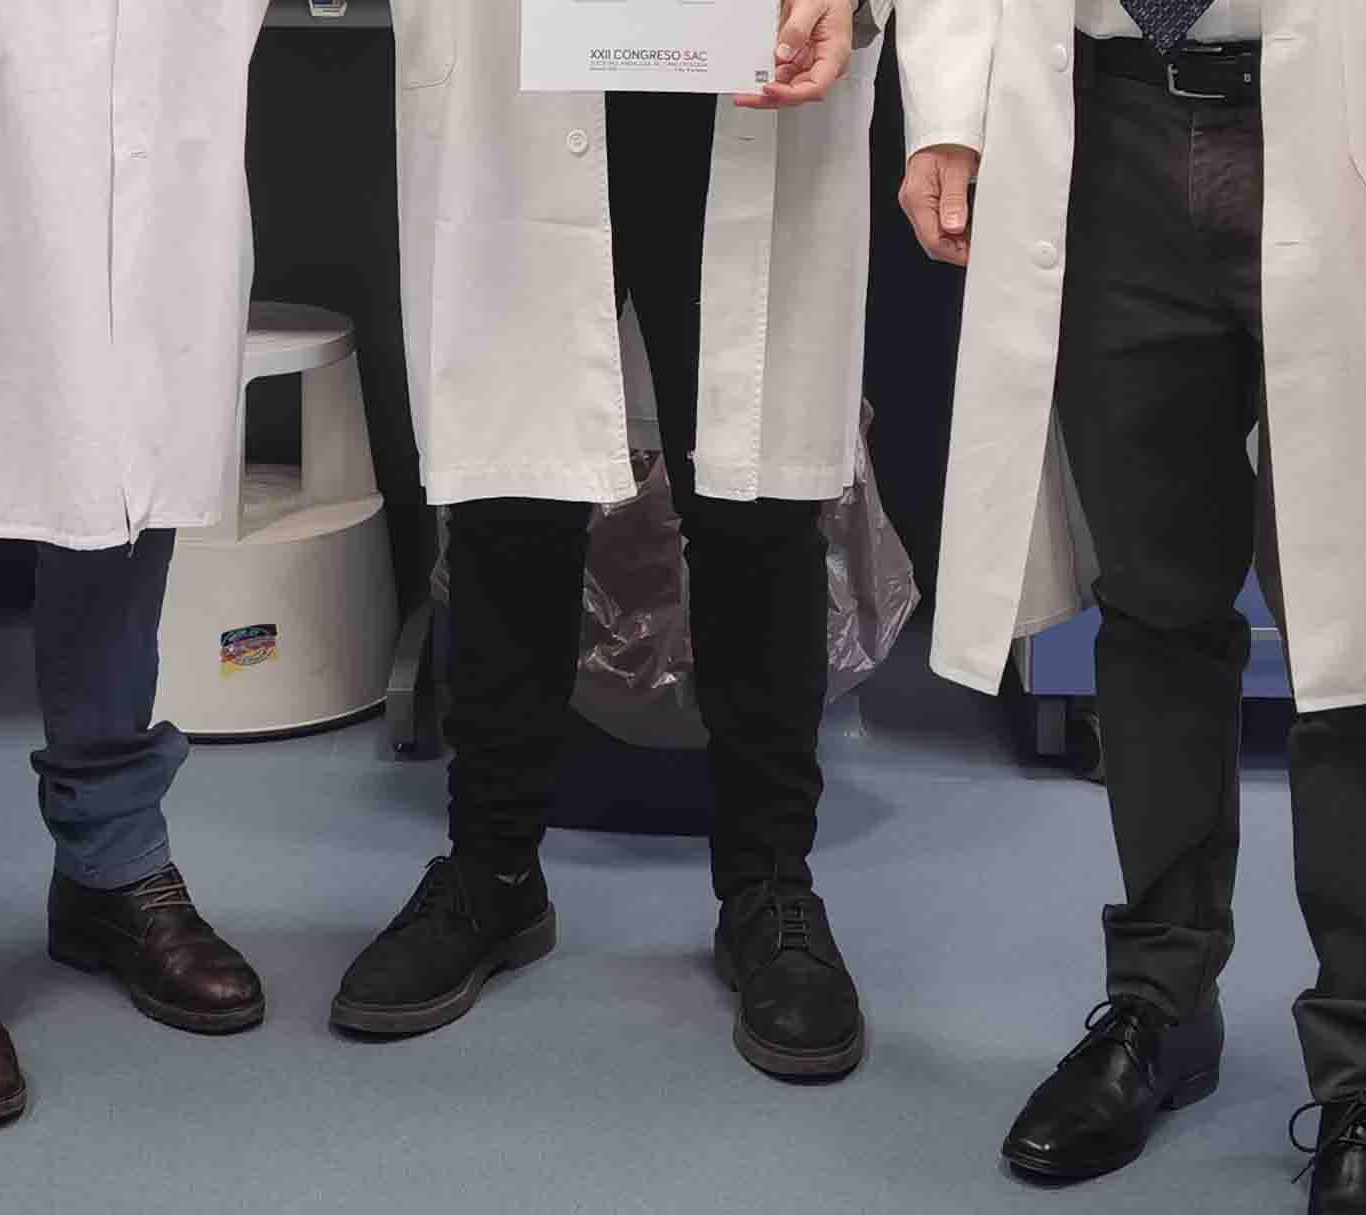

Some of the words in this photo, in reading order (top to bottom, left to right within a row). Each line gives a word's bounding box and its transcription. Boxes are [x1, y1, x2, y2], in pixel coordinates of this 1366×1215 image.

[589, 49, 612, 60] XXII
[613, 49, 682, 61] CONGRESO
[683, 50, 708, 62] SAC
